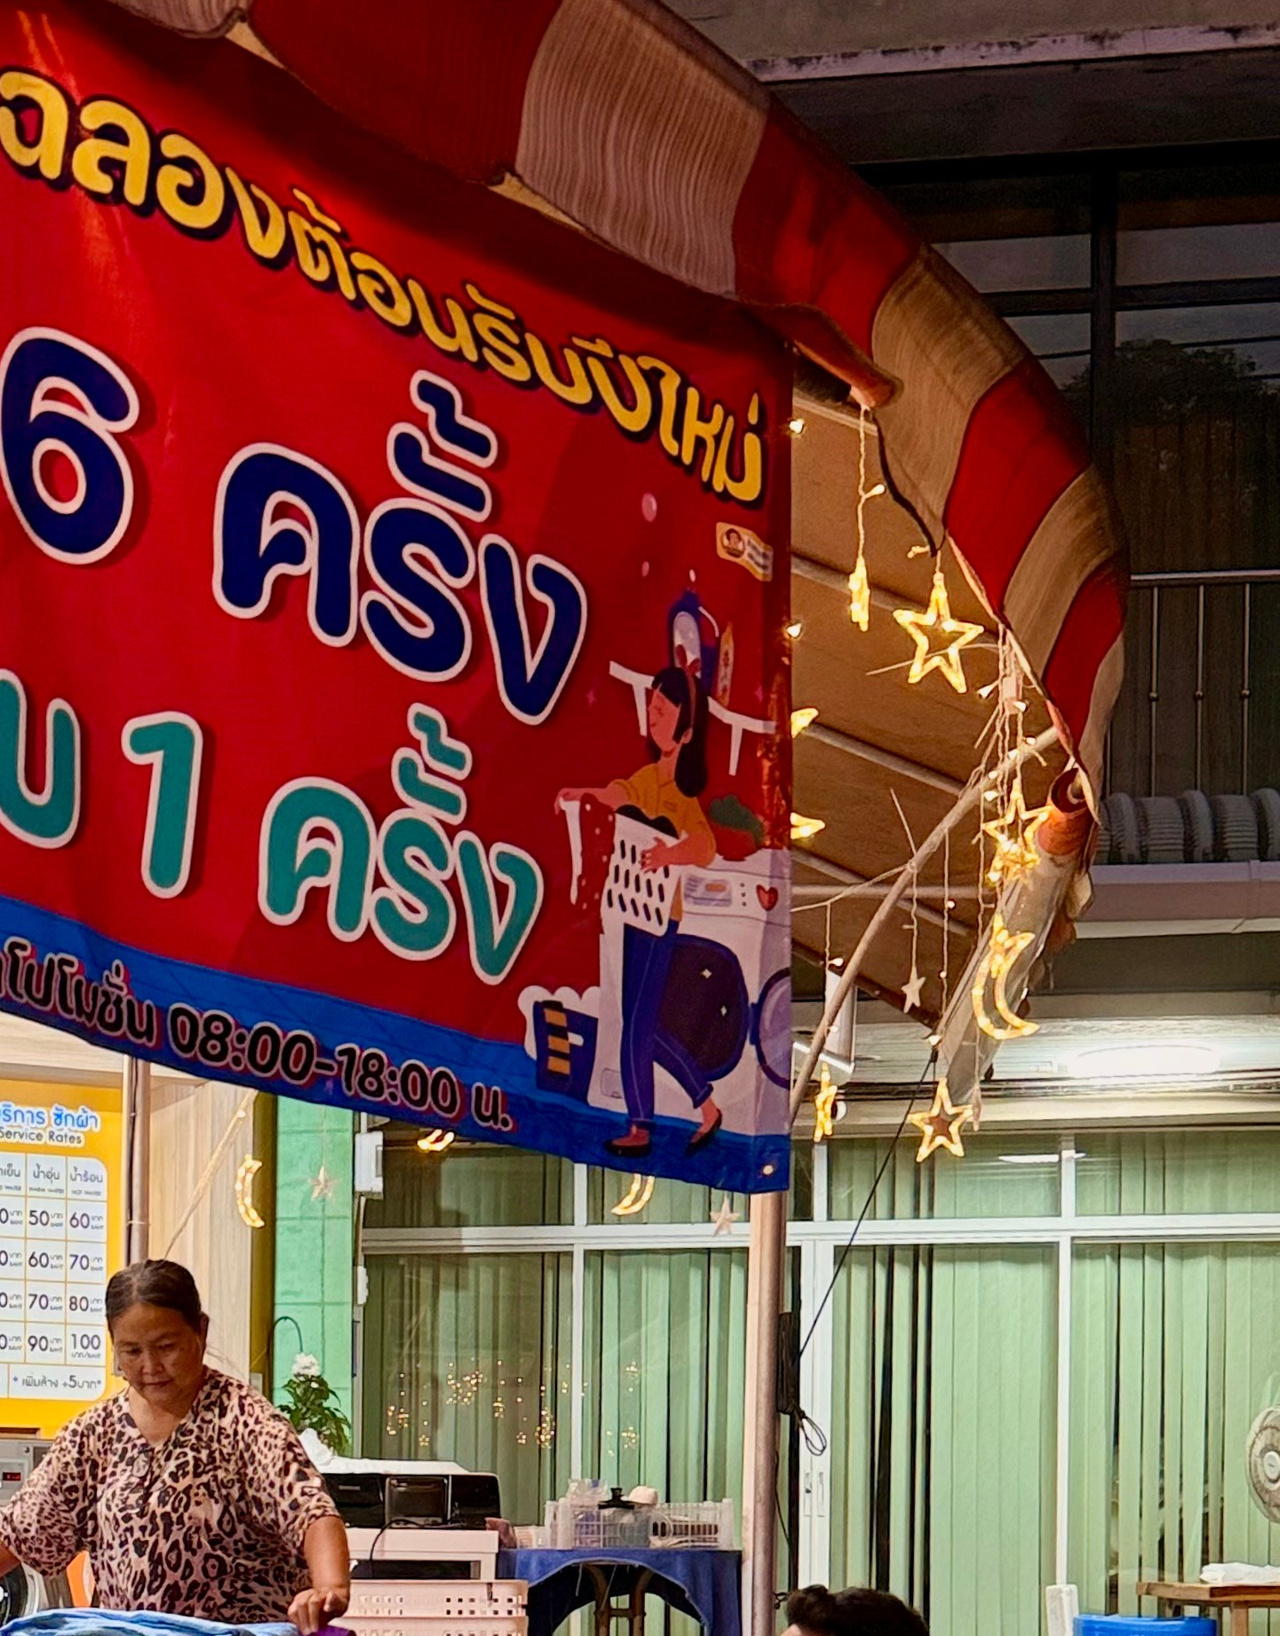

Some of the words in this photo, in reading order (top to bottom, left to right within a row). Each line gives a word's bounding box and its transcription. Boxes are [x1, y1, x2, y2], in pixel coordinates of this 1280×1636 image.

[212, 369, 588, 726] ครั้ง
[121, 711, 203, 899] 1
[256, 702, 543, 986] ครั้ง
[166, 1002, 461, 1117] 08:00-18:00
[470, 1081, 514, 1132] น.
[52, 1104, 98, 1129] ซักผ้า
[48, 1130, 83, 1145] Rates
[28, 1209, 50, 1227] 50
[69, 1211, 90, 1229] 60
[28, 1251, 49, 1269] 60
[69, 1253, 90, 1271] 70
[28, 1293, 49, 1311] 70
[68, 1295, 89, 1312] 80
[27, 1335, 49, 1352] 90
[71, 1333, 102, 1351] 100
